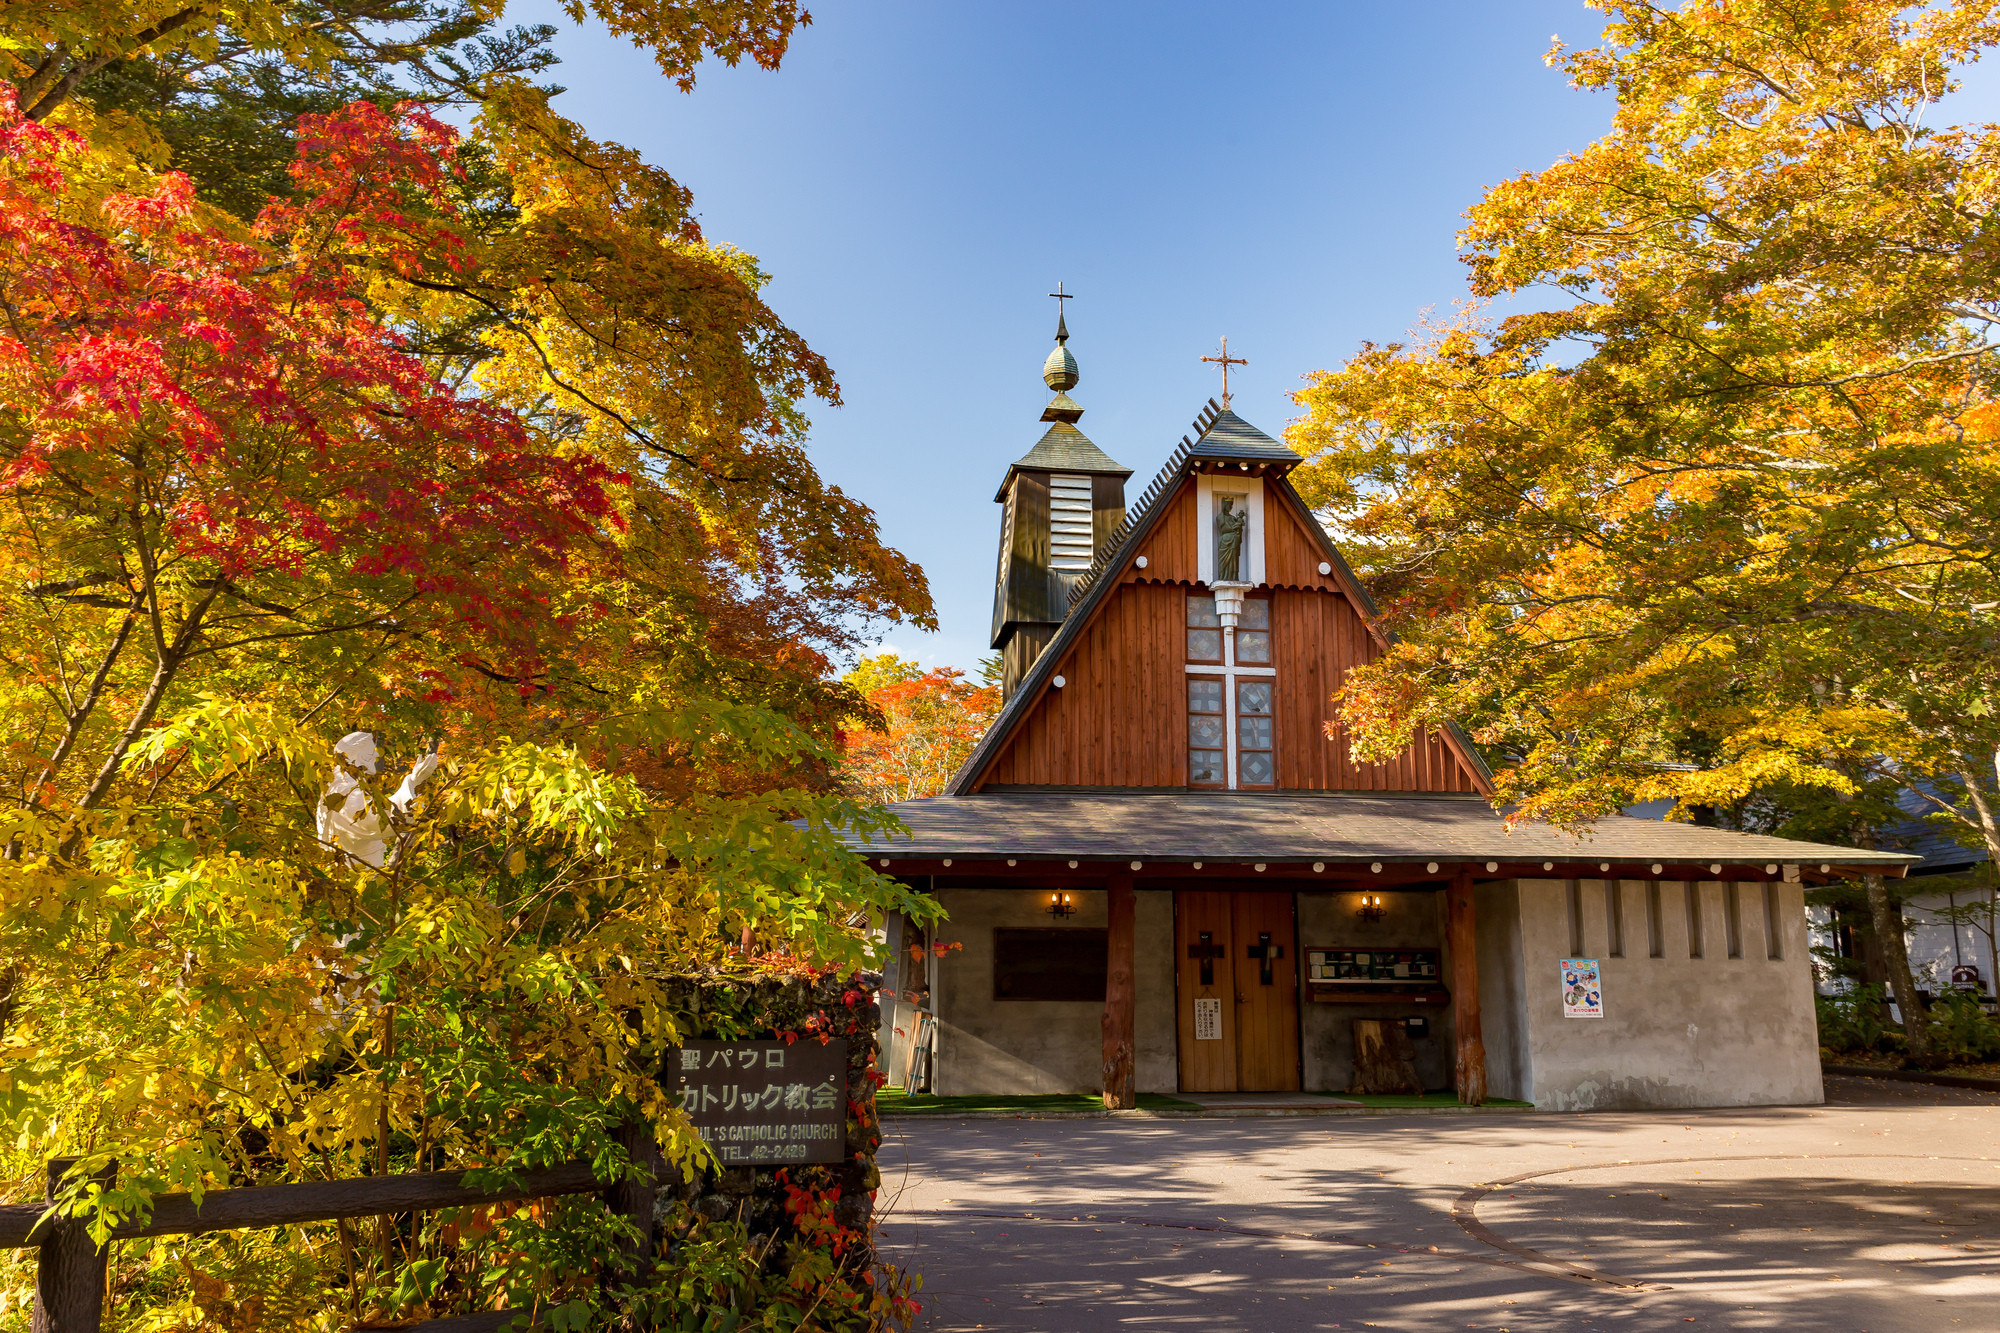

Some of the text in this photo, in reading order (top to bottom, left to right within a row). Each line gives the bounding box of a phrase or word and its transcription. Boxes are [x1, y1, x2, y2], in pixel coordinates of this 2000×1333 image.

[680, 1049, 785, 1070] 聖パウロ
[675, 1082, 839, 1113] カトリック教会
[729, 1124, 787, 1141] CATHOLIC
[790, 1123, 838, 1140] CHURCH
[721, 1145, 807, 1160] TEL. 42-2429
